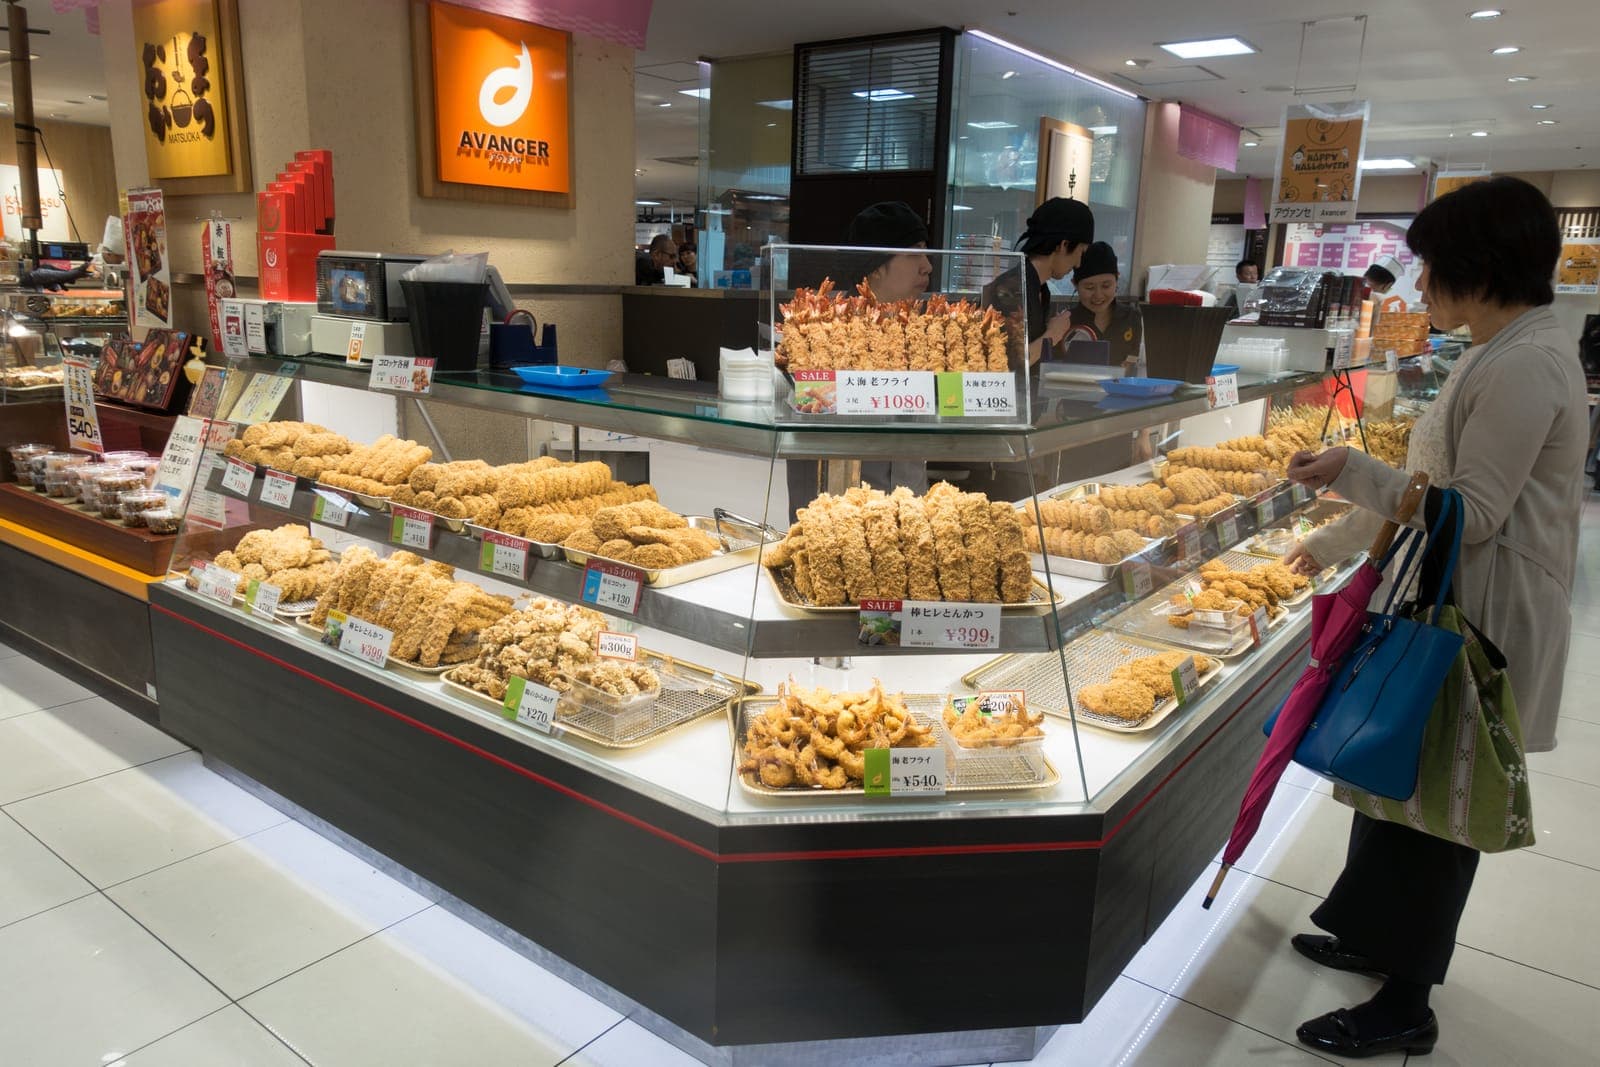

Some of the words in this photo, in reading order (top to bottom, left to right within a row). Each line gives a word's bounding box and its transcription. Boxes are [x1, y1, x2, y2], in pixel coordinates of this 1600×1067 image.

[168, 131, 201, 144] MATSUOKA
[460, 131, 550, 158] AVANCER
[1307, 153, 1338, 162] HAPPY
[1294, 161, 1350, 171] HALLOWEEN
[1274, 207, 1312, 218] アヴァンセ
[1320, 208, 1348, 217] Avancer
[800, 371, 830, 381] SALE
[845, 377, 910, 387] 大海老フライ
[964, 380, 1007, 388] 大海老フライ
[870, 394, 925, 409] ¥1080
[975, 397, 1008, 408] ¥498
[867, 602, 896, 610] SALE
[911, 607, 984, 618] 棒ヒレとんかつ
[945, 627, 990, 643] ¥399
[361, 643, 383, 660] ¥399
[526, 706, 548, 723] ¥270
[892, 756, 931, 765] 海老フライ
[903, 774, 937, 787] ¥540
